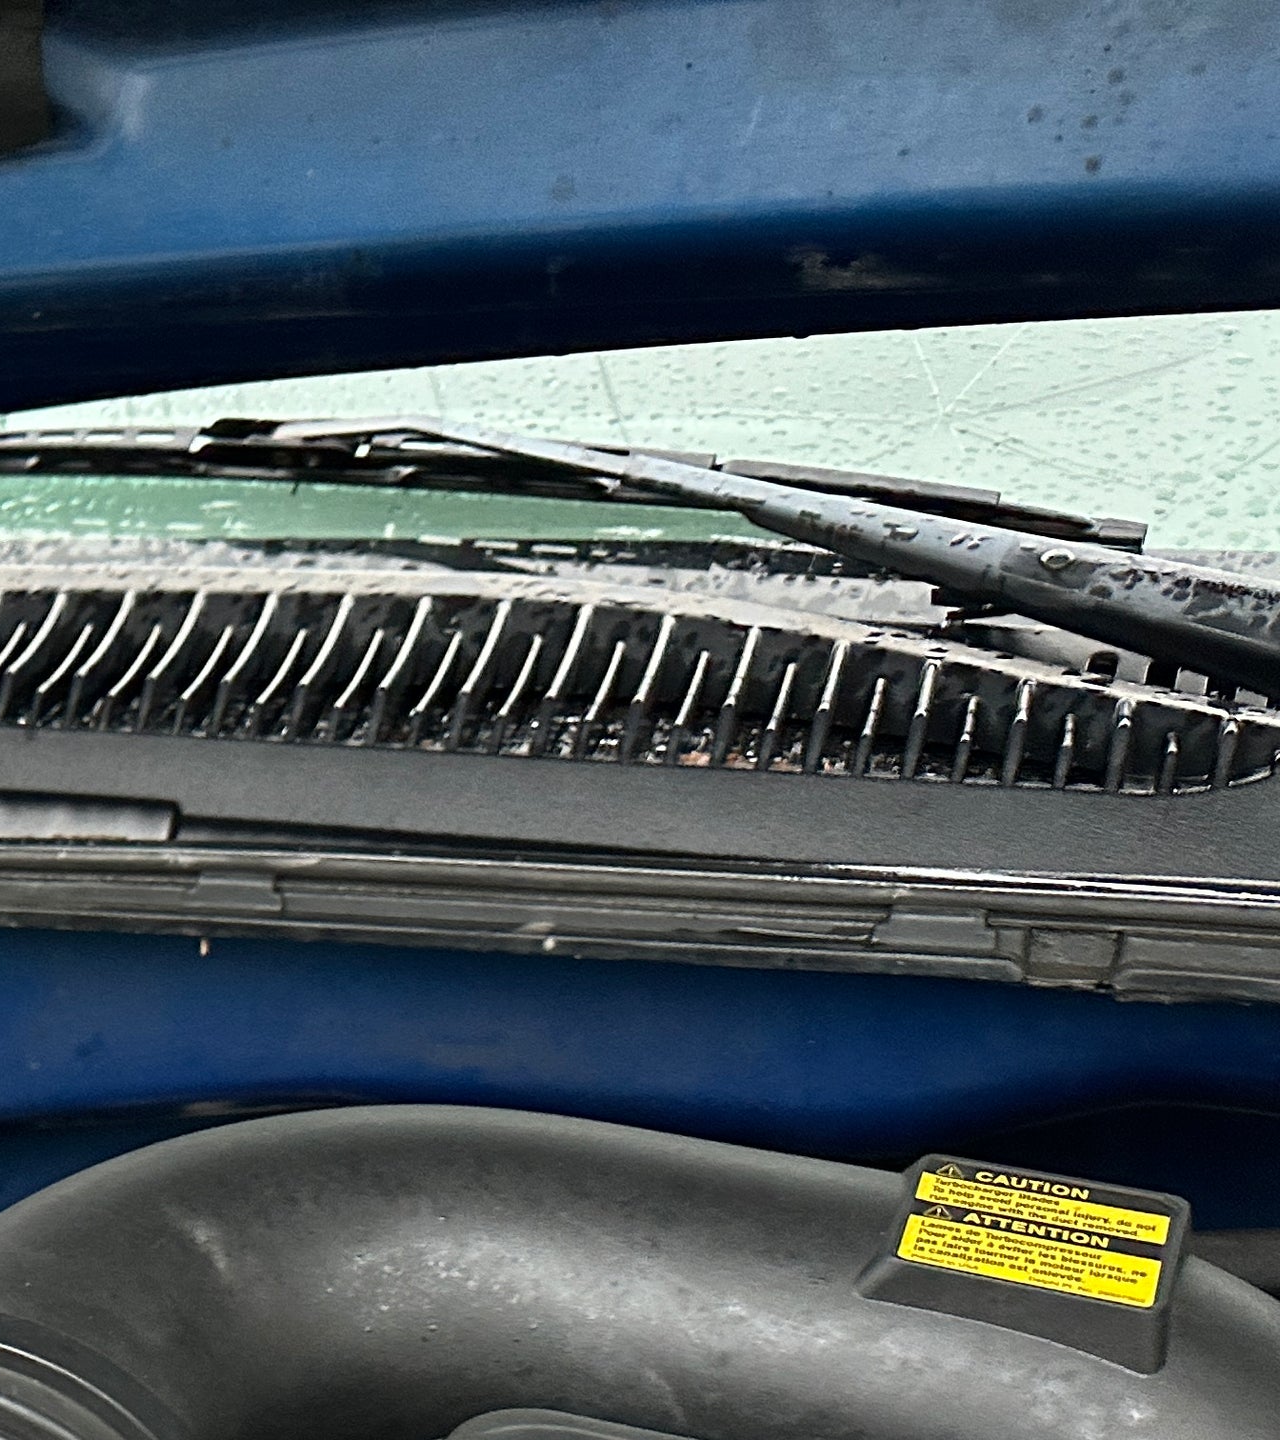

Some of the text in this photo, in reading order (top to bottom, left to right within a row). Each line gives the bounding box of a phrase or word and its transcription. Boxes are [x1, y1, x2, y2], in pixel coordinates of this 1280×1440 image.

[933, 1177, 1060, 1206] Turbocharger Blades
[974, 1169, 1089, 1201] CAUTION
[928, 1193, 1140, 1237] run engine with the duct removed.
[948, 1188, 974, 1199] help
[978, 1194, 1011, 1205] avoid
[1014, 1200, 1069, 1216] personal
[1073, 1210, 1112, 1225] injury,
[1115, 1218, 1133, 1227] do
[1136, 1222, 1156, 1232] not
[962, 1211, 1110, 1248] ATTENTION
[915, 1236, 938, 1247] pas
[941, 1240, 970, 1252] faire
[974, 1246, 1019, 1262] tourner
[1039, 1259, 1084, 1274] moteur
[1088, 1268, 1138, 1284] lorsque
[918, 1227, 947, 1239] Pour
[950, 1233, 983, 1245] aider
[998, 1242, 1034, 1255] éviter
[1037, 1250, 1056, 1259] les
[1060, 1255, 1127, 1274] blessures,
[1130, 1269, 1147, 1278] ne
[920, 1219, 1102, 1260] Lames de Turbocompresseur
[928, 1246, 1007, 1268] canalisation
[1010, 1262, 1028, 1272] est
